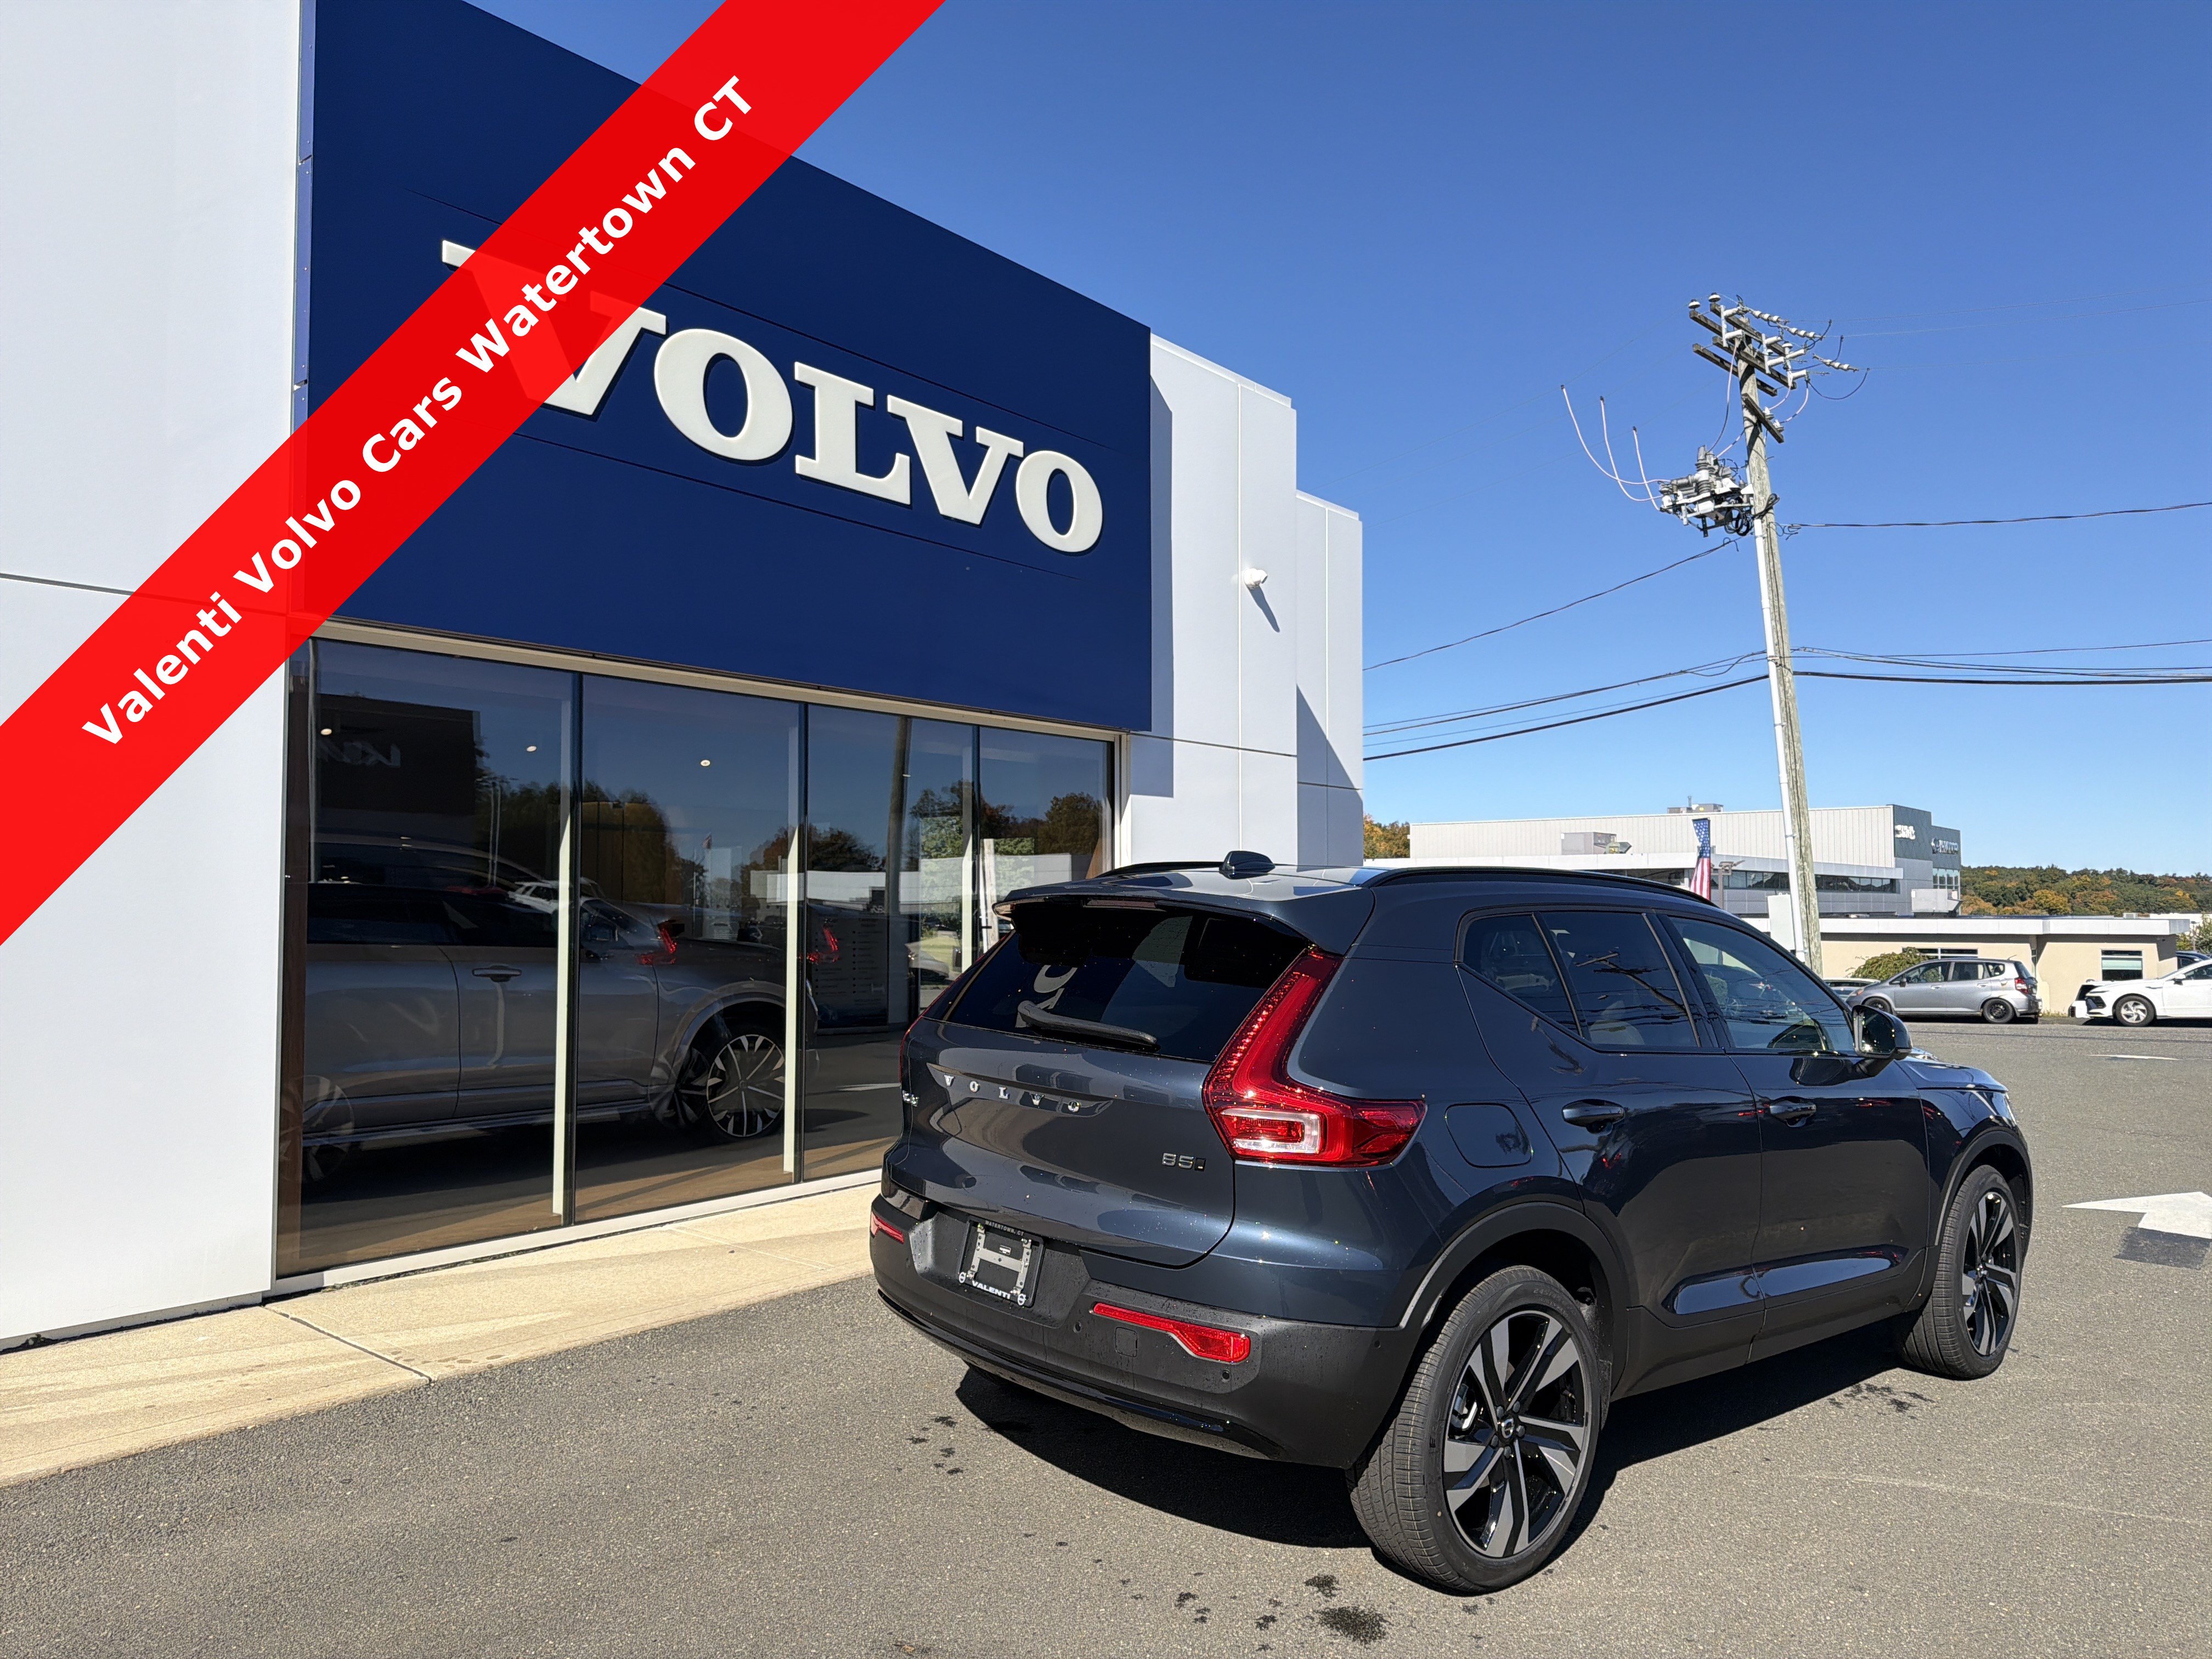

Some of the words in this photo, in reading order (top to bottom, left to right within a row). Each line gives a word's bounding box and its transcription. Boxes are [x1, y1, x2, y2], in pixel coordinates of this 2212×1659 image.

[442, 240, 1103, 552] VOLVO
[944, 1074, 1080, 1113] VOLVO
[972, 1280, 1011, 1299] VALENTI
